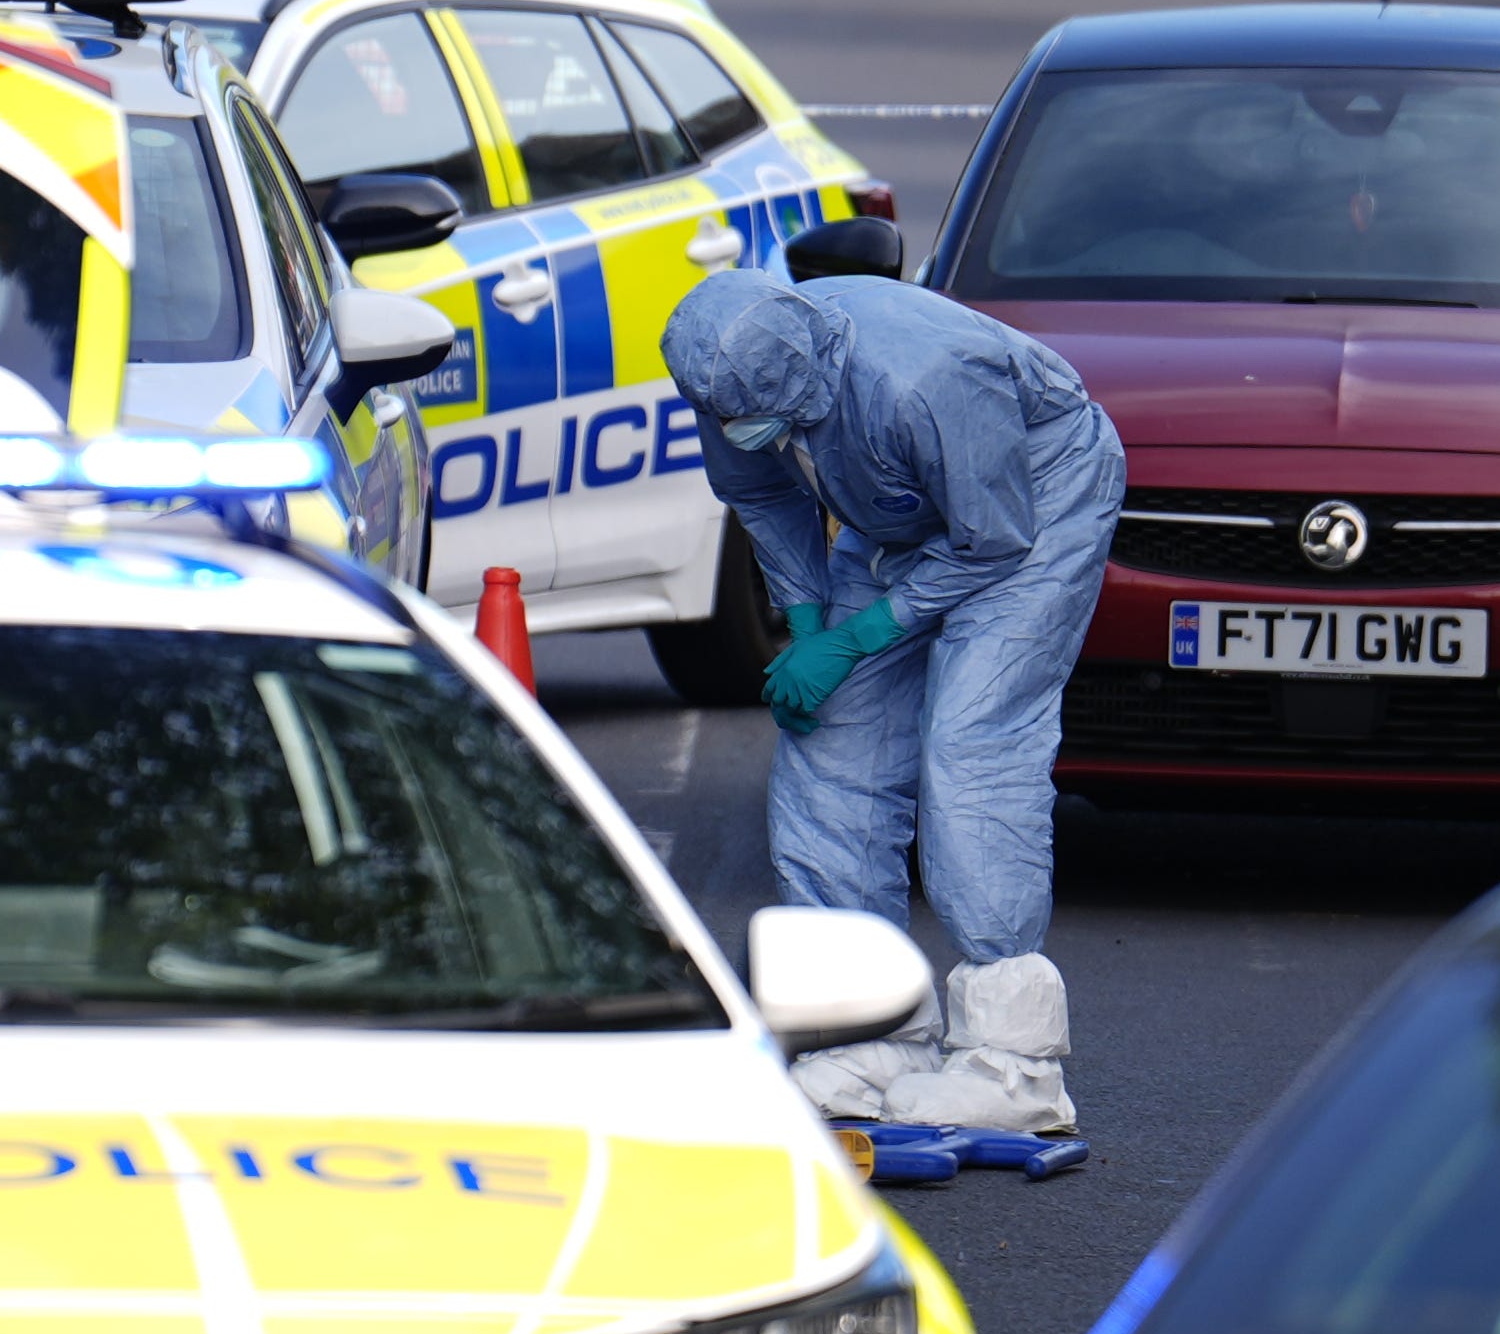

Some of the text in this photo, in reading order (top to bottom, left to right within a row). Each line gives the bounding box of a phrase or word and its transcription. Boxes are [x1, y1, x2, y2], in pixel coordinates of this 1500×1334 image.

[431, 395, 704, 521] OLICE
[1175, 640, 1194, 655] UK
[1217, 609, 1462, 665] FT71 GWG
